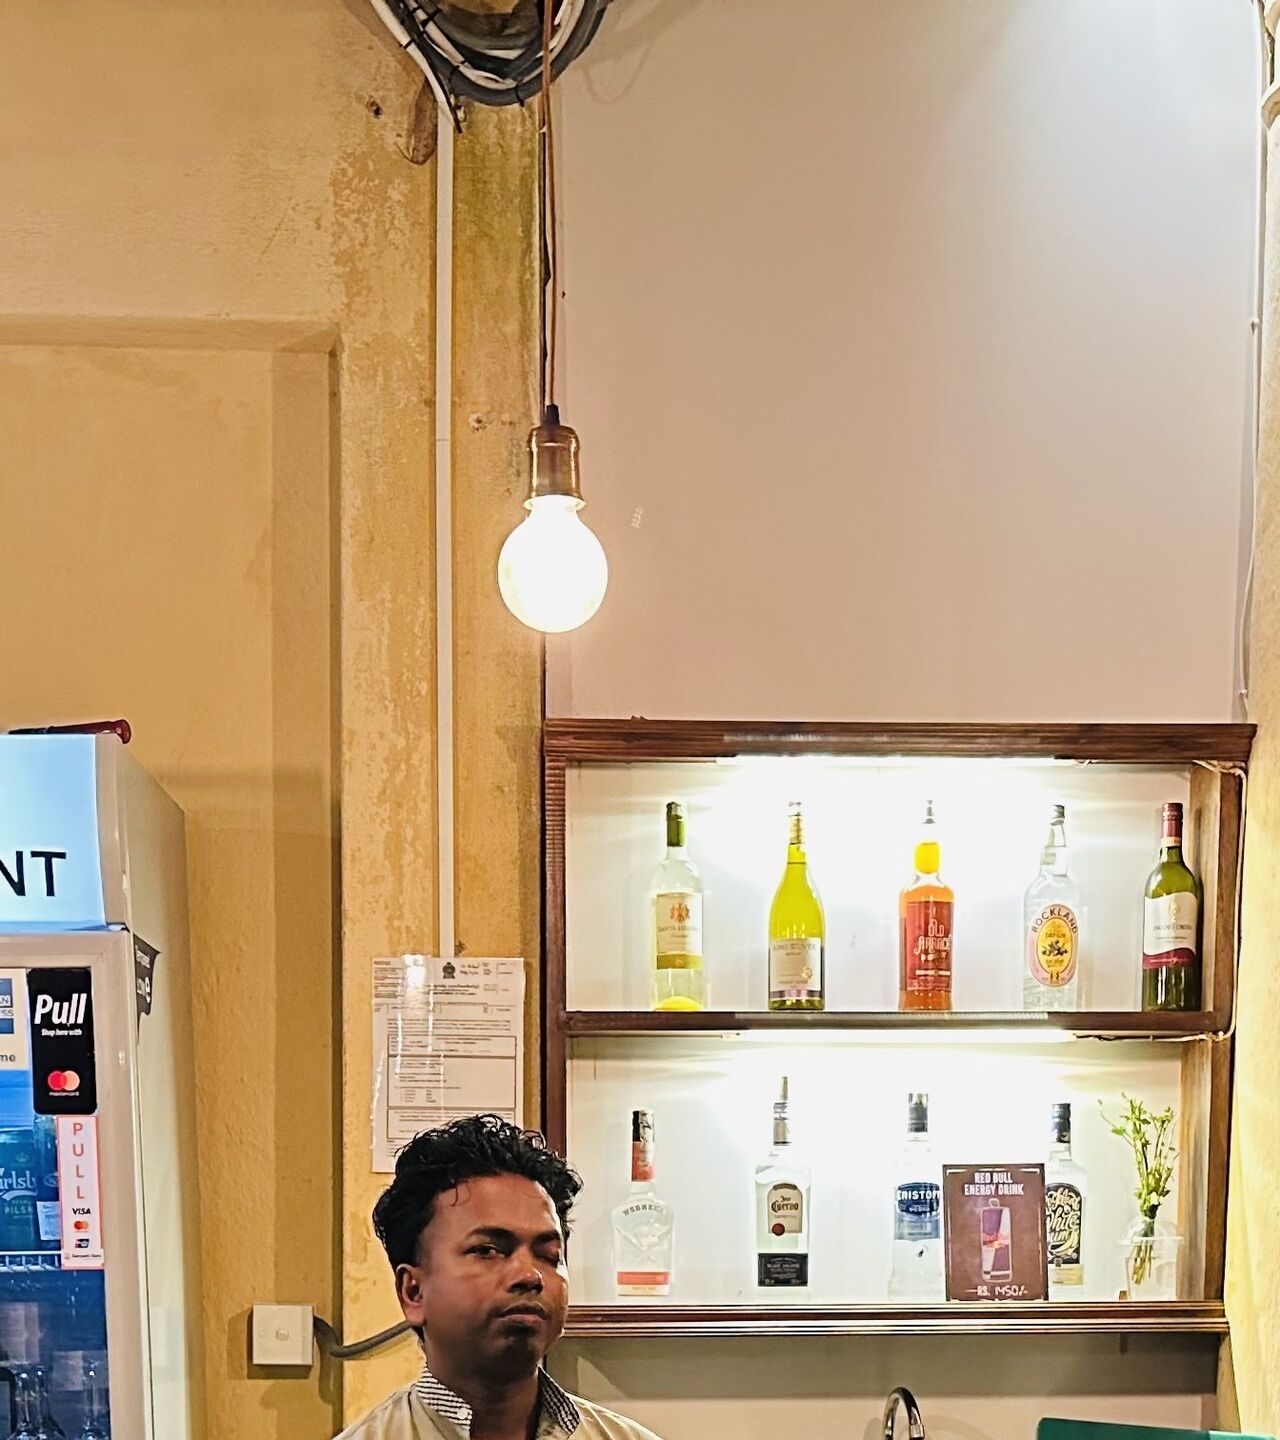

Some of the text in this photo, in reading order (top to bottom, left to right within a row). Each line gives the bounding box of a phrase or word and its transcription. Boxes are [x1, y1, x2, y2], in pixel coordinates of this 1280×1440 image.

[1031, 907, 1078, 934] ROCKLAND
[34, 993, 87, 1025] Pull
[72, 1122, 86, 1199] PULL
[974, 1172, 1013, 1184] RED BULL
[964, 1184, 1024, 1196] ENERGY DRINK
[771, 1200, 799, 1213] Cuervo
